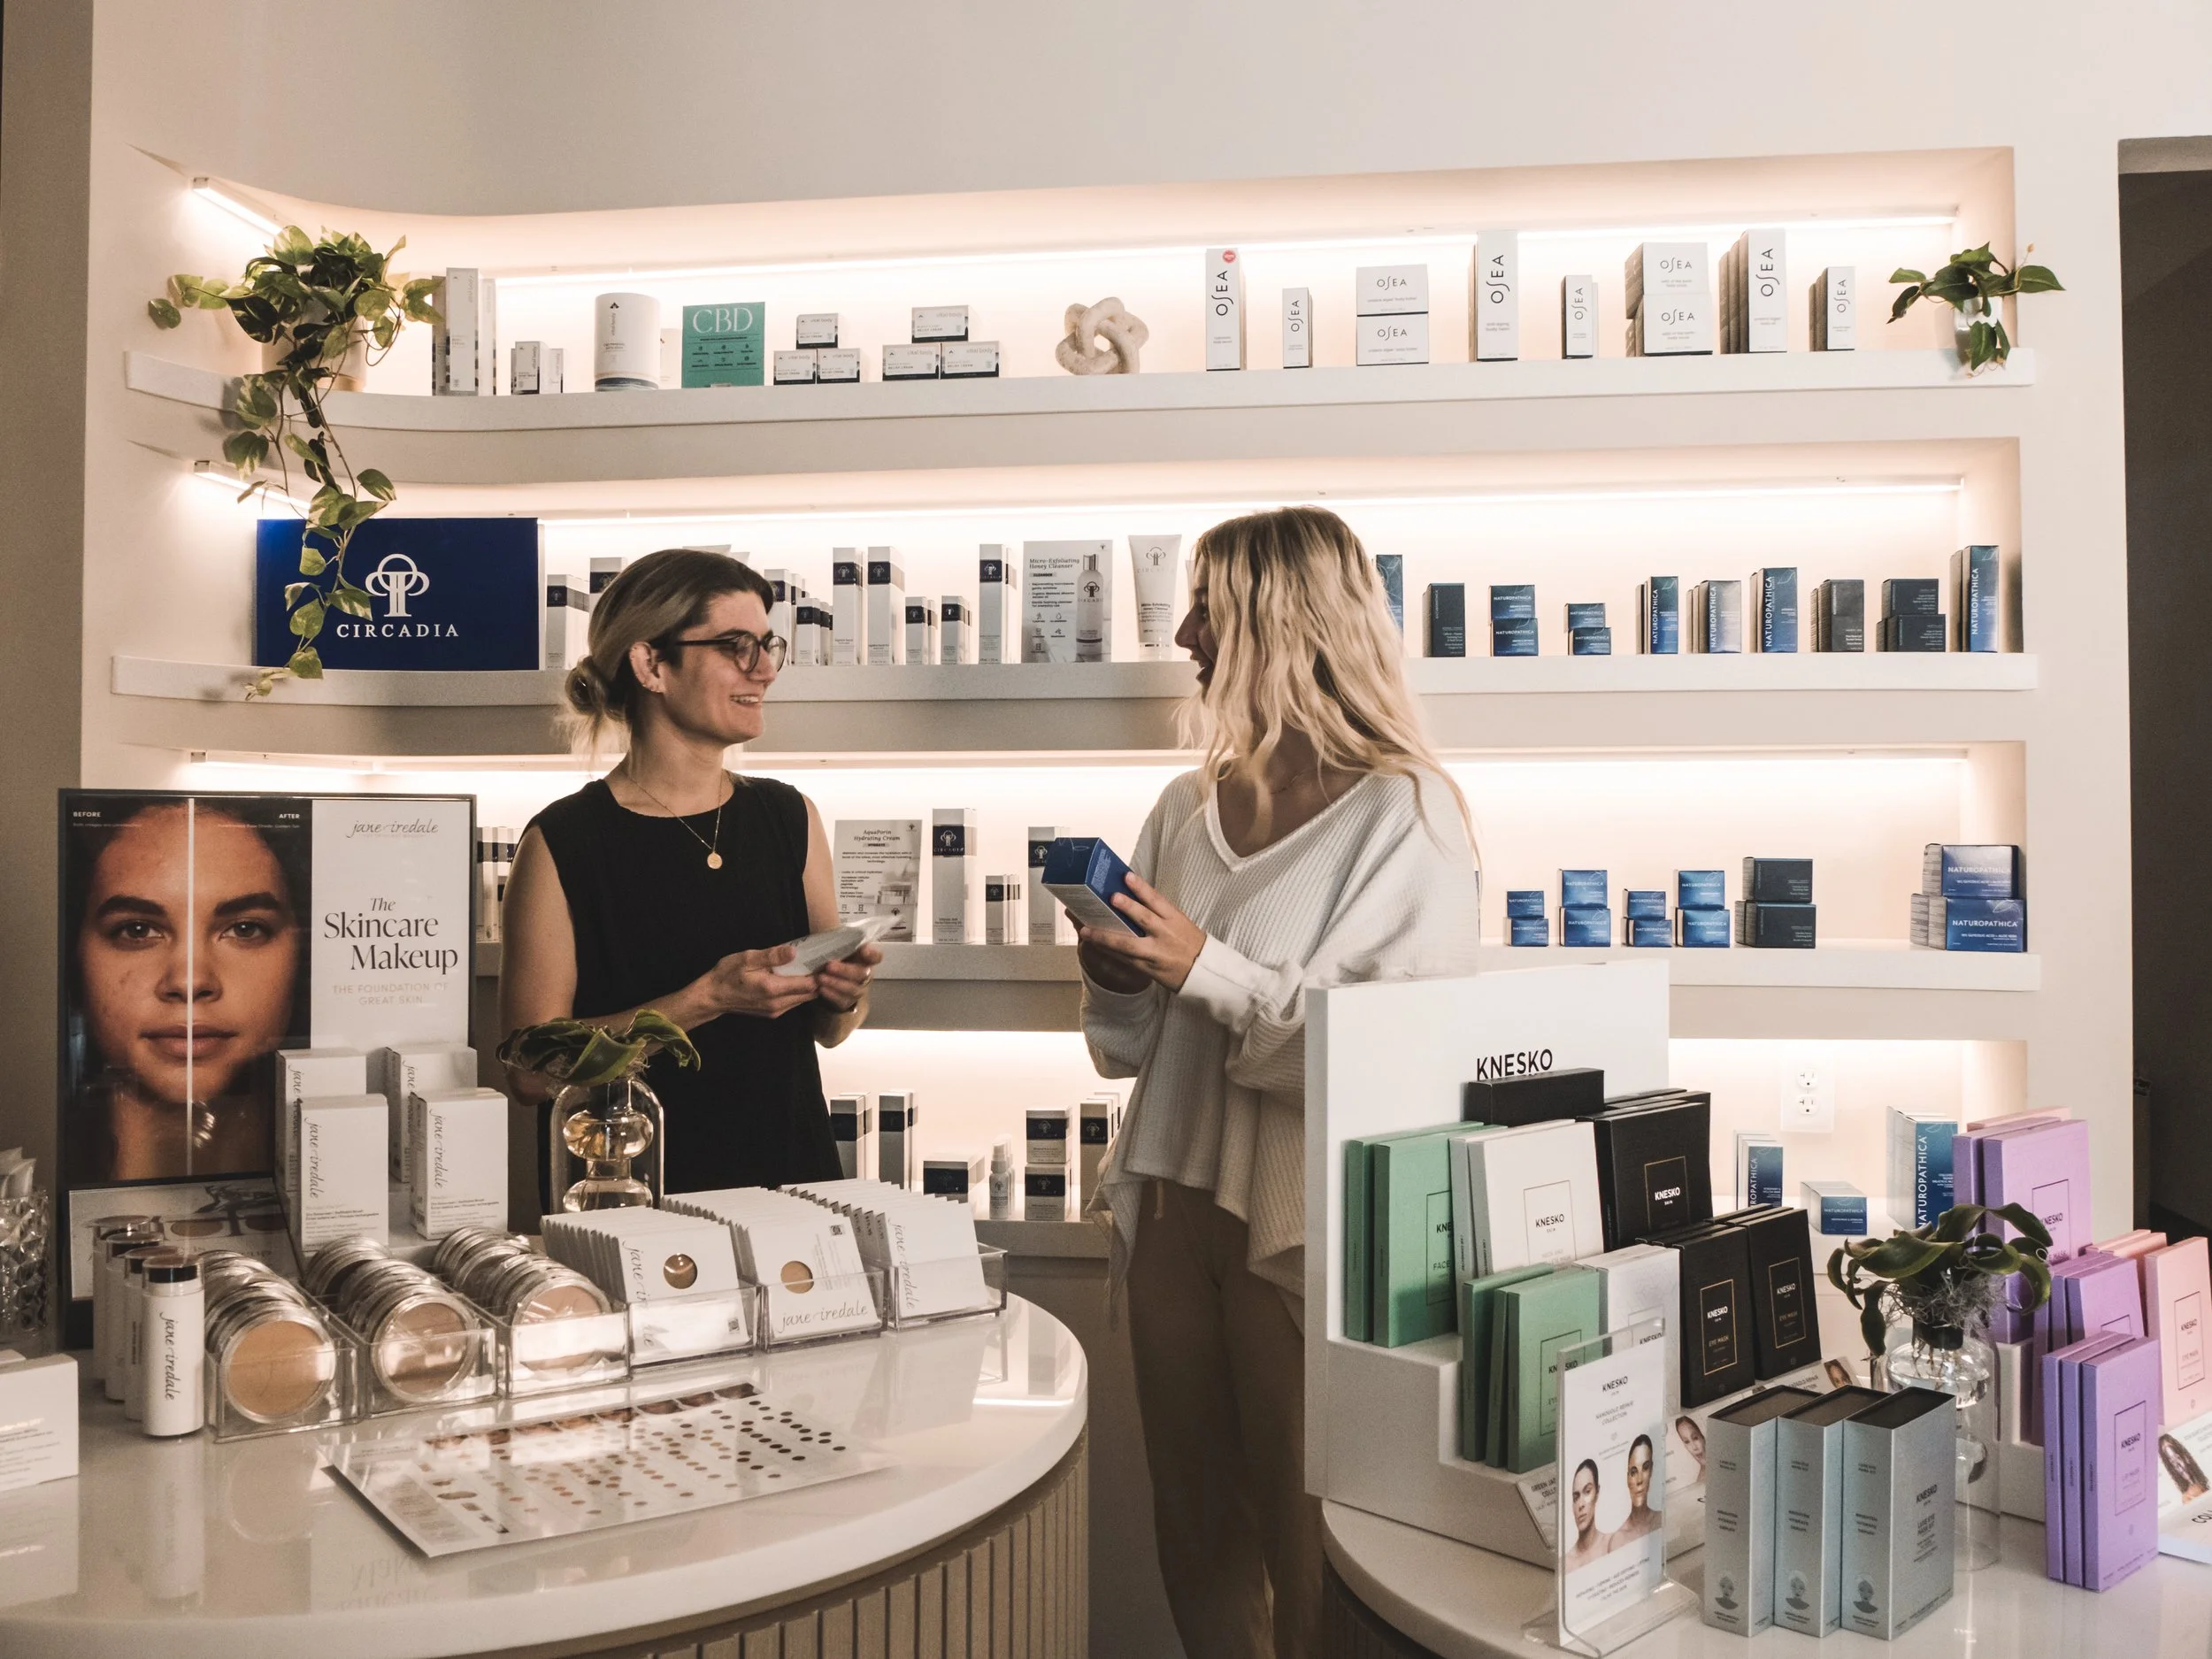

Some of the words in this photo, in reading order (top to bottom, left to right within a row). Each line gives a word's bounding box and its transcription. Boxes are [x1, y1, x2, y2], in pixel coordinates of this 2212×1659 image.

[1660, 257, 1693, 273] OSEA
[1755, 248, 1780, 297] OSEA
[1376, 275, 1408, 291] OSEA
[1486, 255, 1510, 303] OSEA
[1210, 270, 1234, 316] OSEA
[1833, 279, 1851, 313] OSEA
[1574, 288, 1587, 320] OSEA
[692, 307, 753, 334] CBD
[1287, 299, 1304, 332] OSEA
[1661, 309, 1695, 326] OSEA
[1377, 326, 1408, 342] OSEA
[336, 623, 459, 638] CIRCADIA
[346, 820, 382, 839] jane
[388, 818, 439, 833] iredale
[370, 897, 396, 911] The
[324, 911, 439, 939] Skincare
[350, 942, 458, 975] Makeup
[333, 985, 353, 994] THE
[357, 983, 429, 994] FOUNDATION
[434, 982, 449, 991] OF
[358, 995, 395, 1005] GREAT
[399, 995, 423, 1004] SKIN
[403, 1060, 416, 1089] jane
[1476, 1048, 1554, 1082] KNESKO
[288, 1064, 303, 1094] jane
[303, 1118, 319, 1148] jane
[429, 1109, 443, 1140] jane
[310, 1150, 326, 1199] iredale
[434, 1141, 449, 1189] iredale
[1655, 1187, 1680, 1201] KNESKO
[1436, 1222, 1453, 1233] KNE
[1535, 1213, 1565, 1228] KNESKO
[622, 1240, 645, 1281] jane
[887, 1218, 905, 1253] jane
[900, 1256, 920, 1310] iredale
[1777, 1283, 1796, 1295] KNESKO
[775, 1312, 811, 1334] jane
[818, 1299, 868, 1321] iredale
[1707, 1305, 1728, 1319] KNESKO
[159, 1312, 175, 1346] jane
[2180, 1318, 2198, 1331] KNESKO
[1717, 1335, 1729, 1345] MASK
[165, 1348, 181, 1401] iredale
[1548, 1360, 1578, 1374] KNSKO
[1602, 1376, 1628, 1393] KNESKO
[1595, 1405, 1619, 1419] NANOGOLD
[1601, 1411, 1628, 1425] COLLECTION
[2121, 1432, 2141, 1449] KNESKO
[1532, 1482, 1548, 1493] GREEN
[1916, 1484, 1938, 1504] KNESKO
